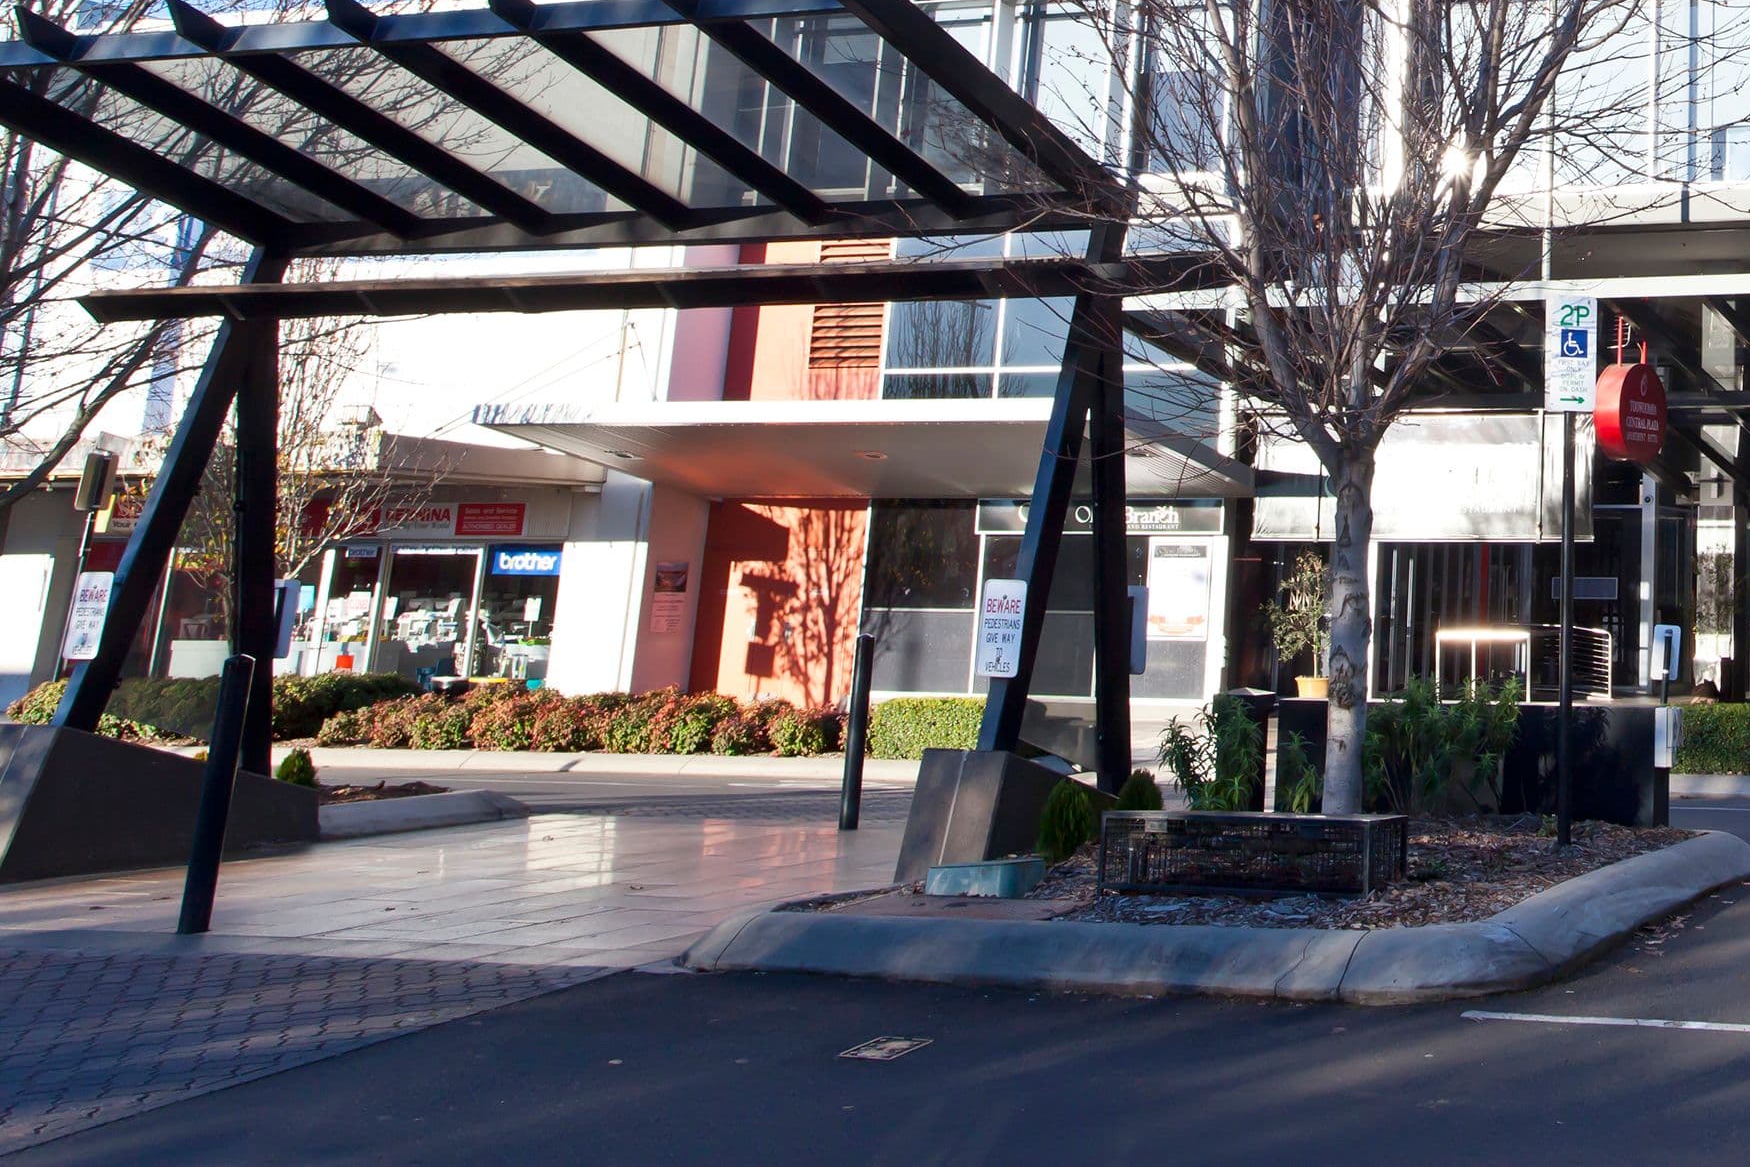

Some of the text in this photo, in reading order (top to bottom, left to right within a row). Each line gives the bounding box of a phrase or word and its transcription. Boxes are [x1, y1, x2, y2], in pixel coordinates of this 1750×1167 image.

[1560, 304, 1590, 327] 2P
[499, 549, 557, 571] brother
[80, 588, 109, 603] BEWARE
[986, 598, 1021, 614] BEWARE
[984, 618, 1021, 630] PEDESTRIANS
[985, 632, 1016, 644] GIVE WAY
